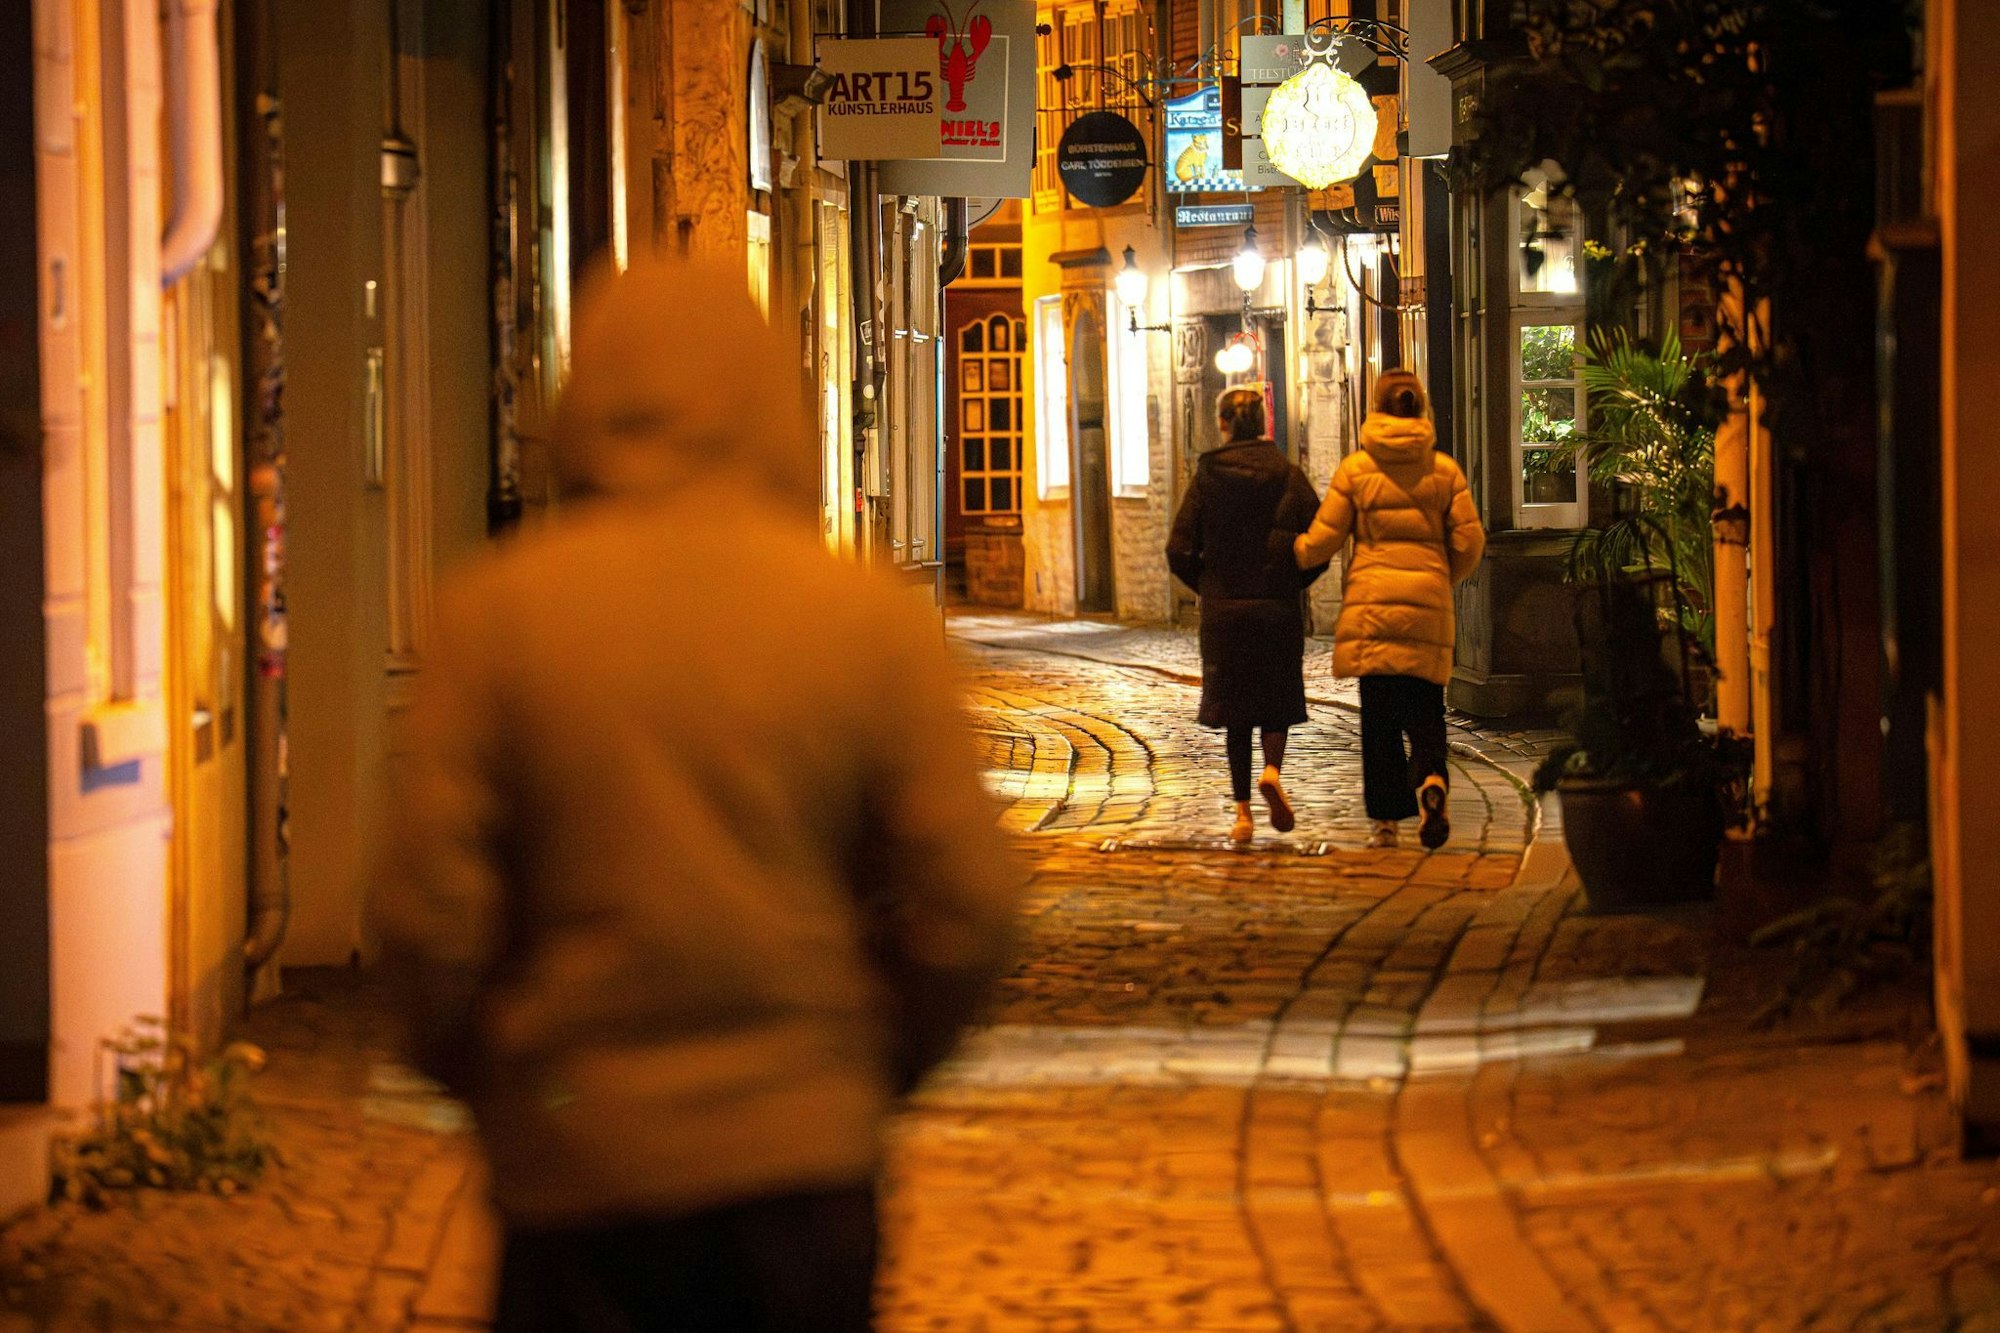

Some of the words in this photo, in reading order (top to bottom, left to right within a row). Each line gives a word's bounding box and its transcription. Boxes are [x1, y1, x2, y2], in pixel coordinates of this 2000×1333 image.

[828, 101, 933, 115] KÜNSTLERHAUS
[1226, 118, 1240, 136] S
[1061, 161, 1087, 171] CARL
[1178, 209, 1253, 223] Restaurant
